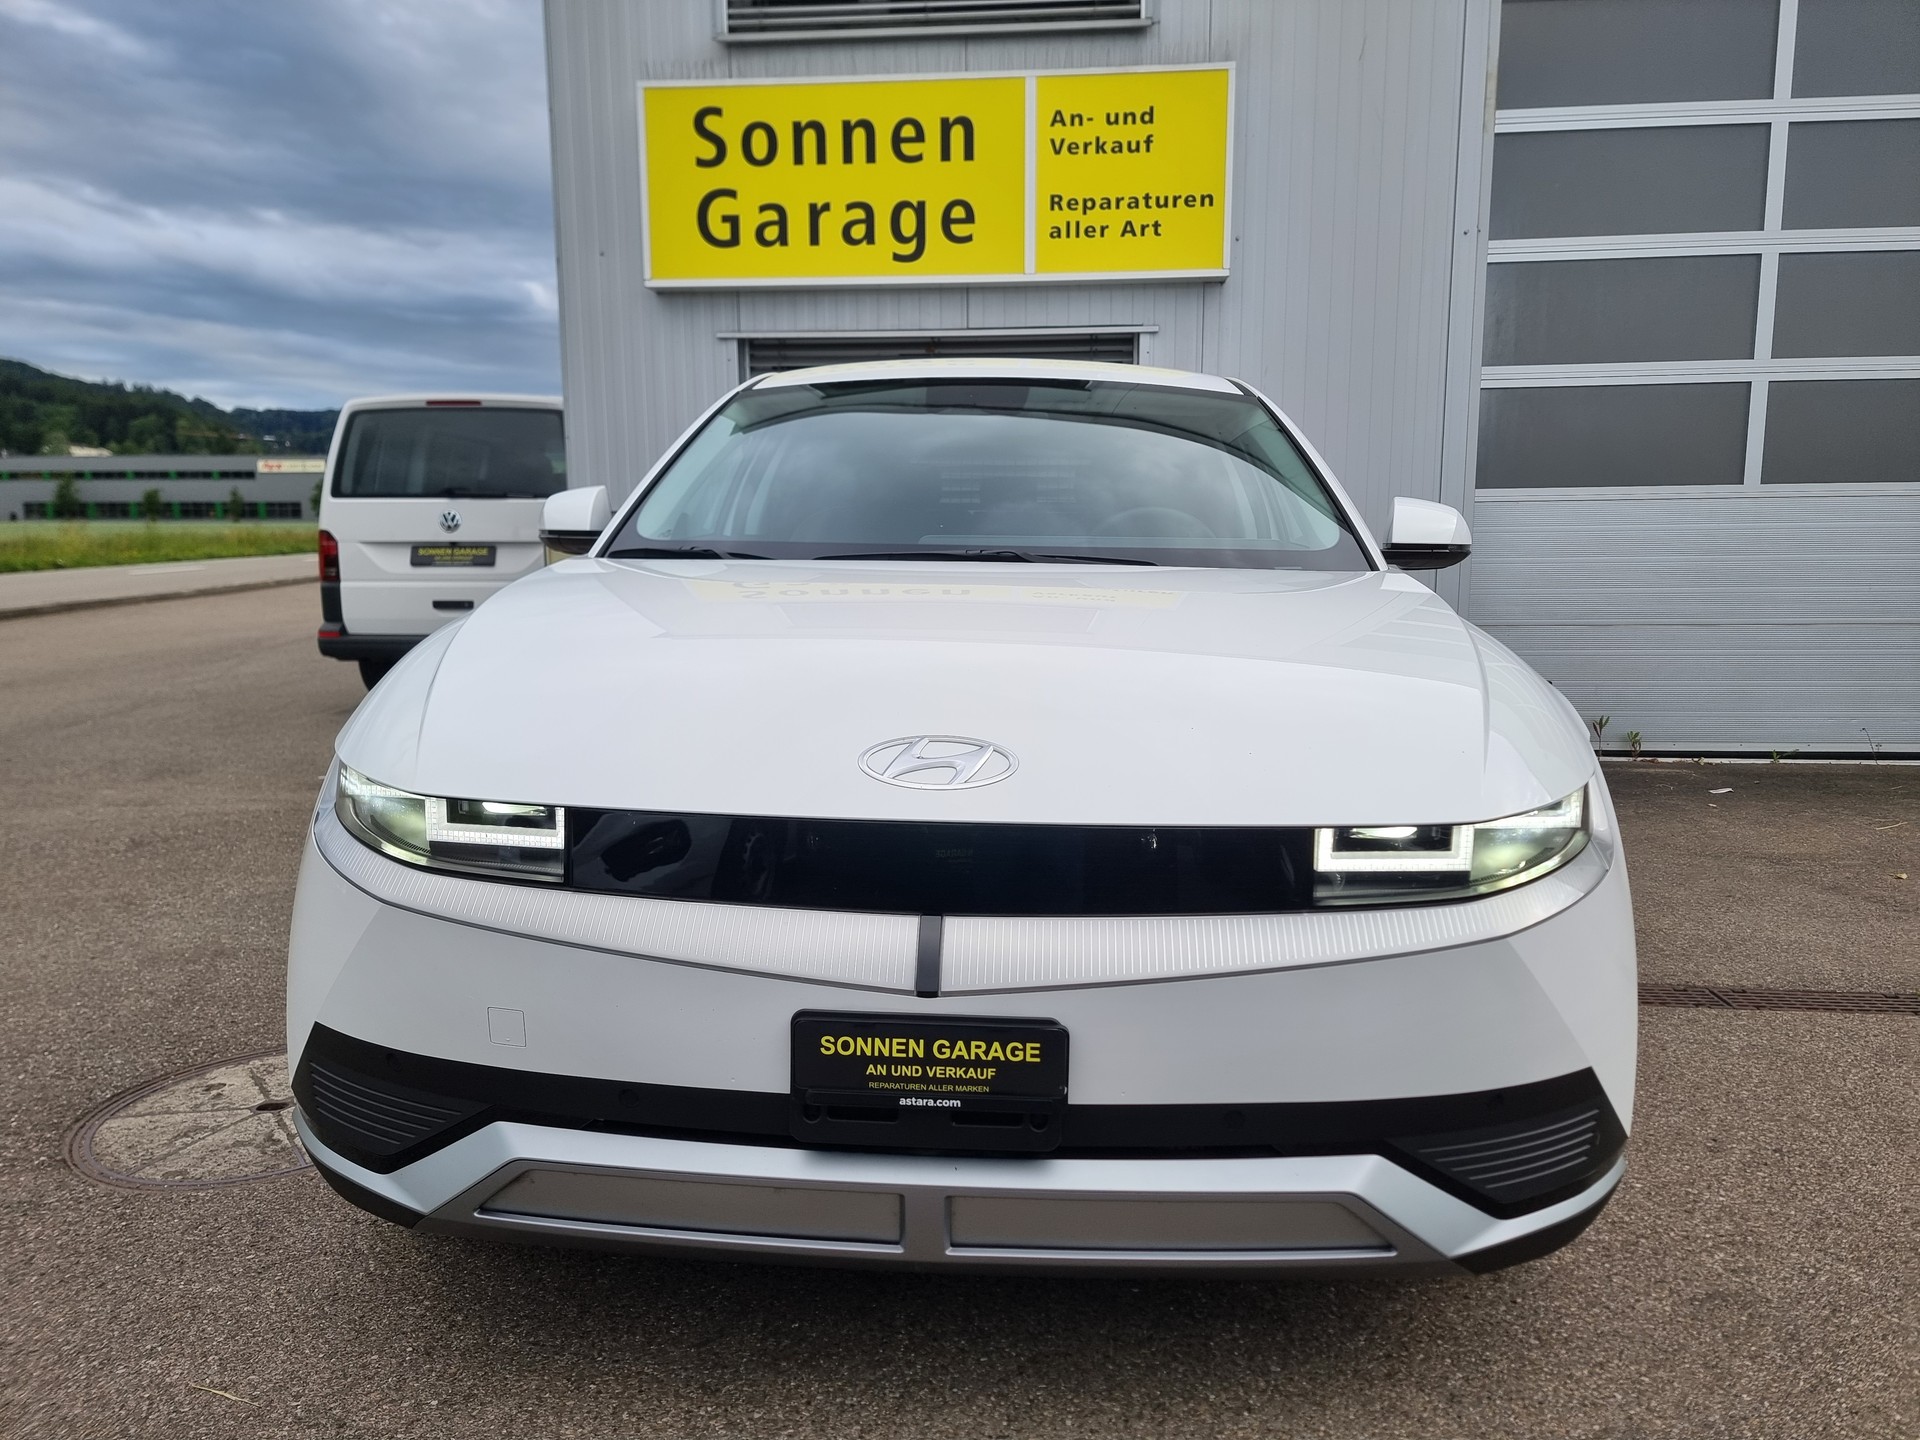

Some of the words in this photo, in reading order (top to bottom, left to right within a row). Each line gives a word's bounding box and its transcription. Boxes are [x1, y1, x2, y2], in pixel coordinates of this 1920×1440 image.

[1050, 109, 1094, 128] An-
[1105, 105, 1155, 126] und
[693, 106, 976, 169] Sonnen
[1050, 134, 1154, 156] Verkauf
[1049, 192, 1215, 216] Reparaturen
[696, 188, 976, 263] Garage
[1049, 220, 1109, 239] aller
[1120, 219, 1162, 238] Art
[418, 547, 452, 556] SONNEN
[453, 547, 489, 556] GARAGE
[819, 1035, 925, 1059] SONNEN
[932, 1039, 1042, 1063] GARAGE
[866, 1064, 887, 1076] AN
[891, 1065, 923, 1077] UND
[926, 1066, 997, 1080] VERKAUF
[868, 1081, 927, 1092] REPARATUREN
[928, 1084, 954, 1093] ALLER
[955, 1085, 990, 1094] MARKEN
[899, 1096, 962, 1108] astara.com
